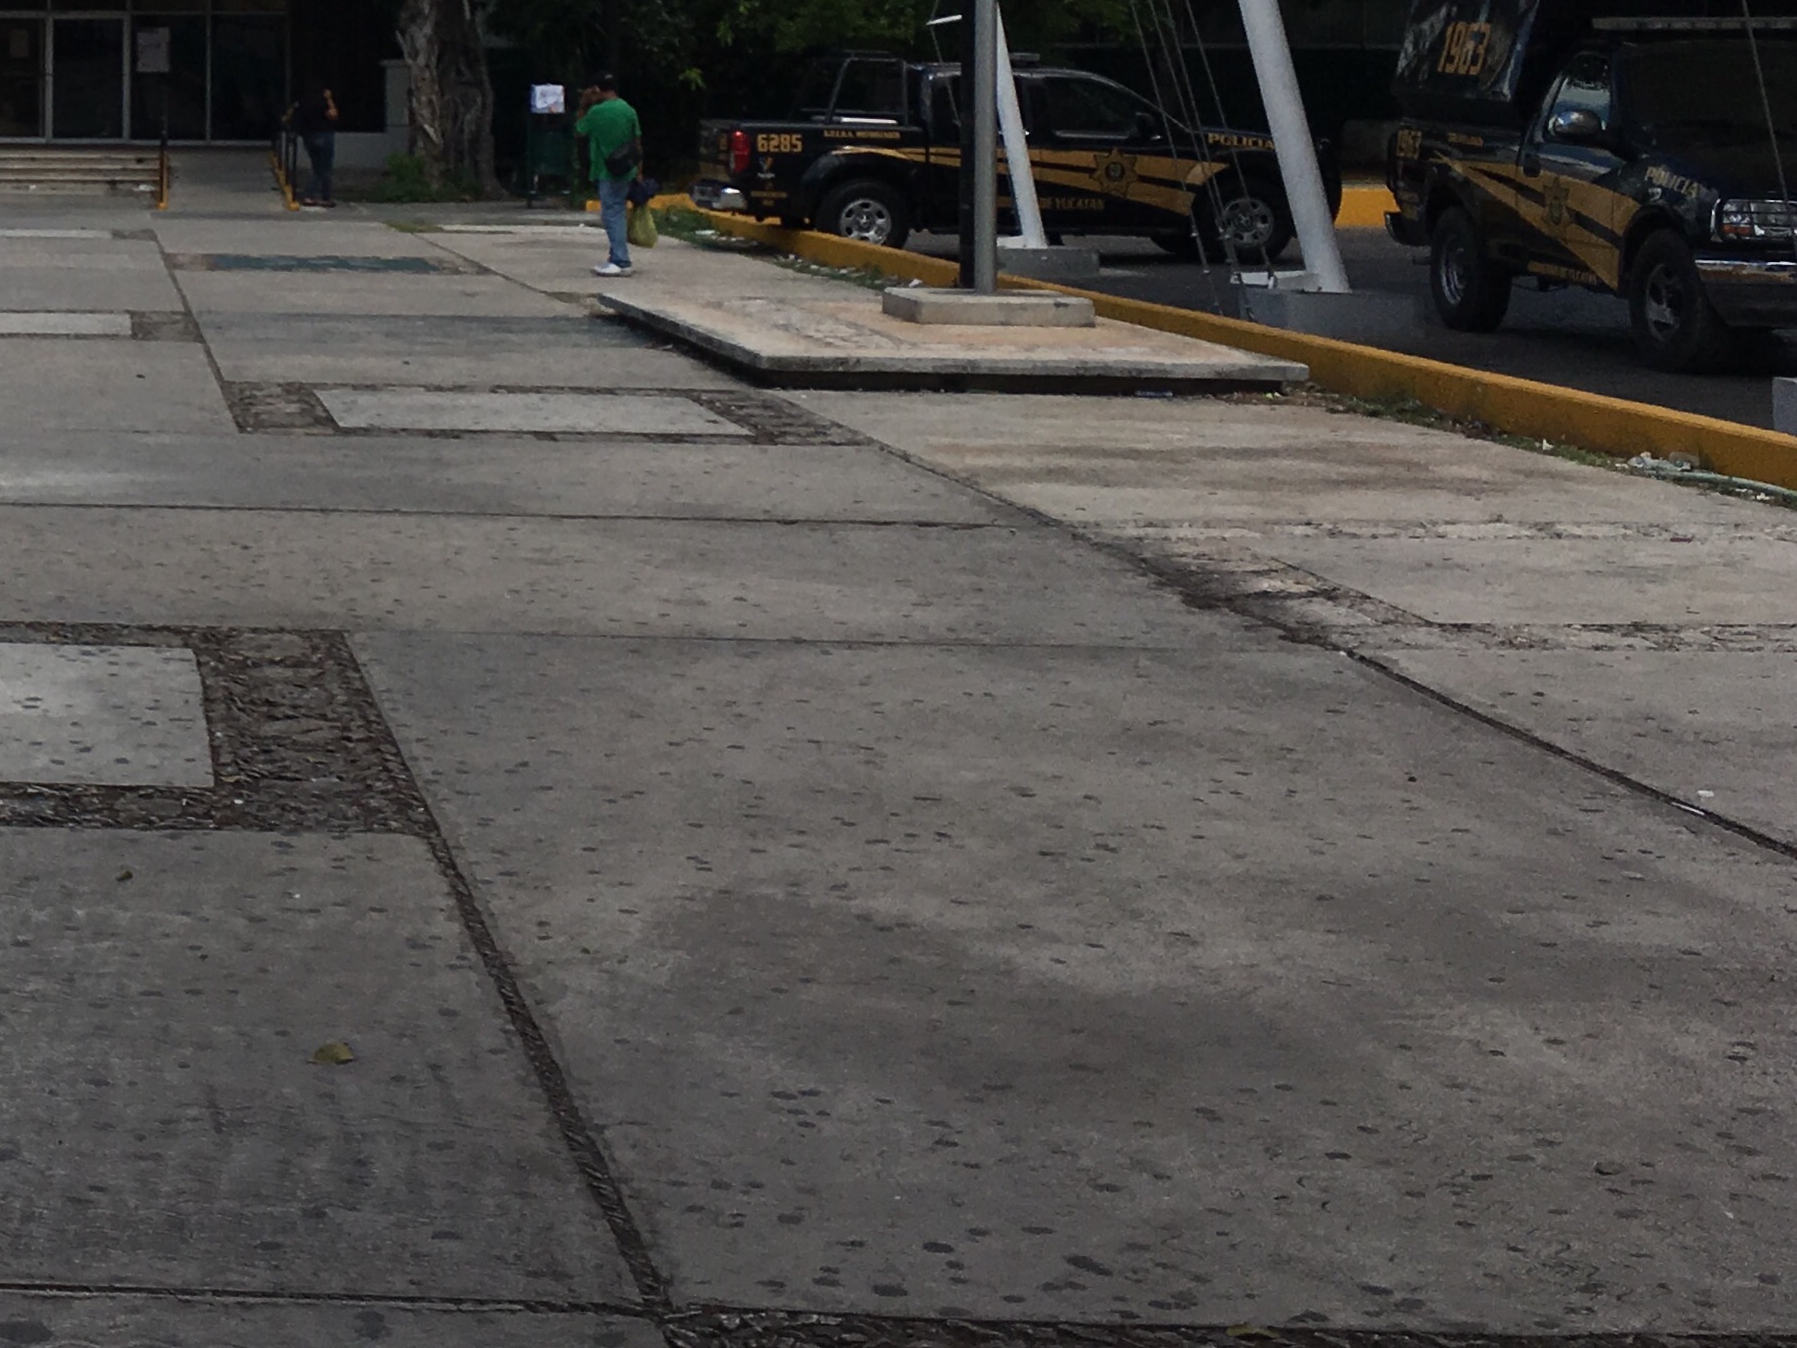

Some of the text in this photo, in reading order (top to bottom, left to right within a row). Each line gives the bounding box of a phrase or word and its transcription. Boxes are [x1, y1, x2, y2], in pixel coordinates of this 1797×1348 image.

[756, 132, 804, 153] 6285
[1207, 132, 1275, 150] POLICIA
[1644, 165, 1700, 199] POLICIA
